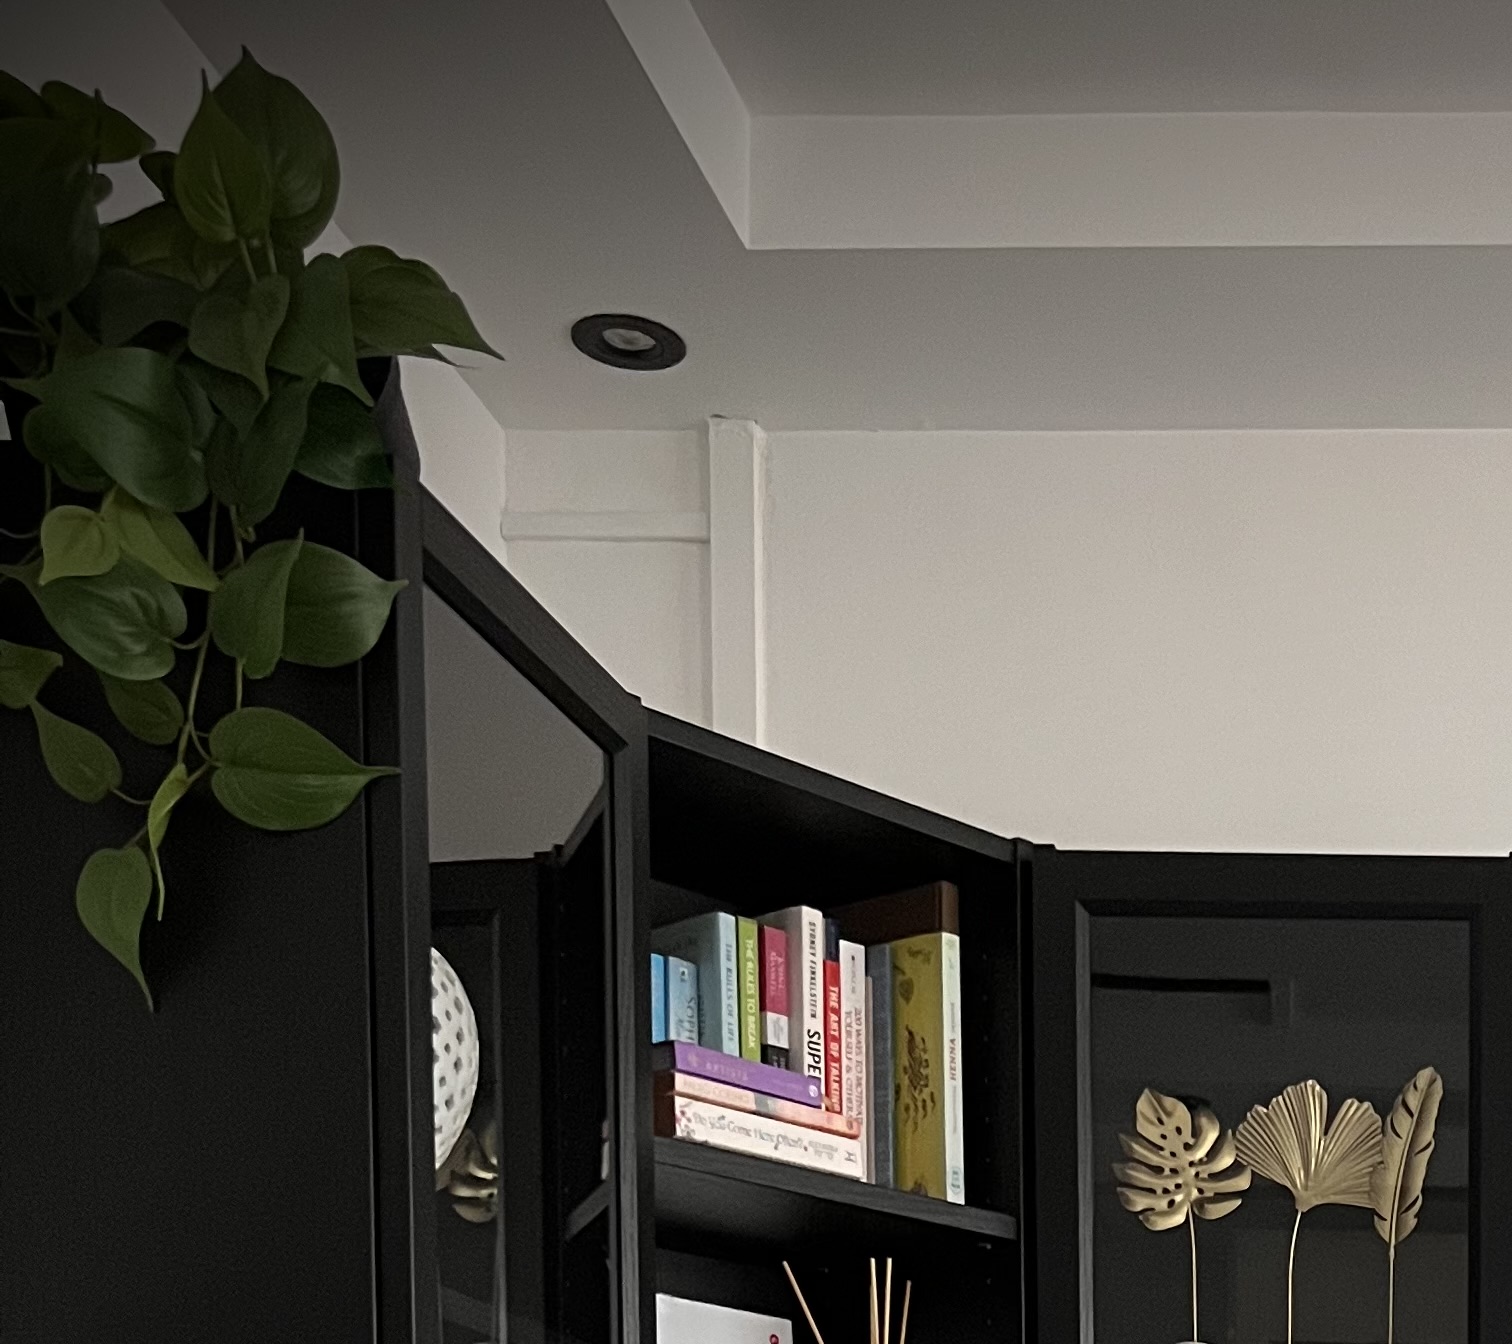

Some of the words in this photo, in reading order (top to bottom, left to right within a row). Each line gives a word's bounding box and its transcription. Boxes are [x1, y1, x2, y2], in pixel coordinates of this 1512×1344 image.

[808, 921, 817, 957] SYDNEY
[746, 961, 755, 995] RULES
[809, 959, 818, 1019] FINKELSTEIN
[828, 984, 839, 1008] THE
[747, 1014, 757, 1049] BREAK
[829, 1012, 840, 1035] ART
[830, 1041, 840, 1058] OF
[949, 1038, 957, 1081] HENNA
